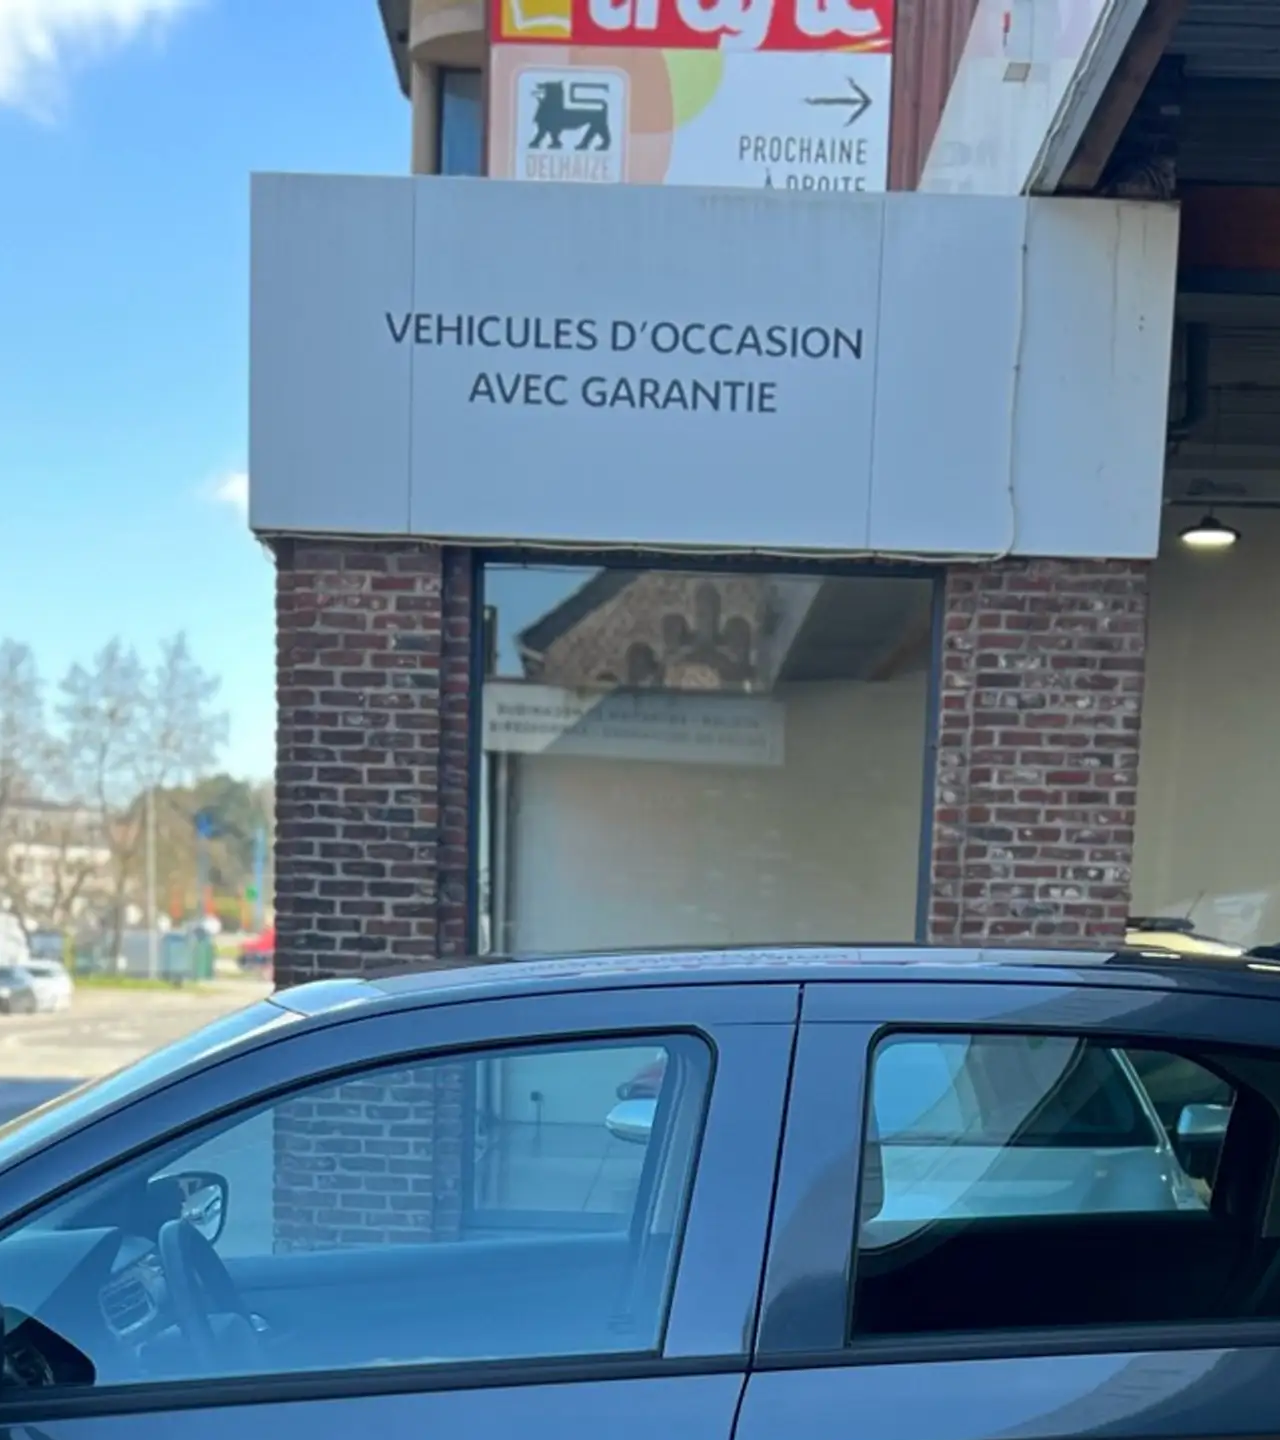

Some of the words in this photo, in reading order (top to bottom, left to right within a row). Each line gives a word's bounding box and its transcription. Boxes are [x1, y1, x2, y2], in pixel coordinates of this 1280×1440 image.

[524, 153, 609, 182] DELHAIZE
[738, 134, 869, 166] PROCHAINE
[385, 311, 598, 351] VEHICULES
[610, 319, 864, 360] D'OCCASION
[468, 372, 569, 406] AVEC
[580, 375, 778, 413] GARANTIE
